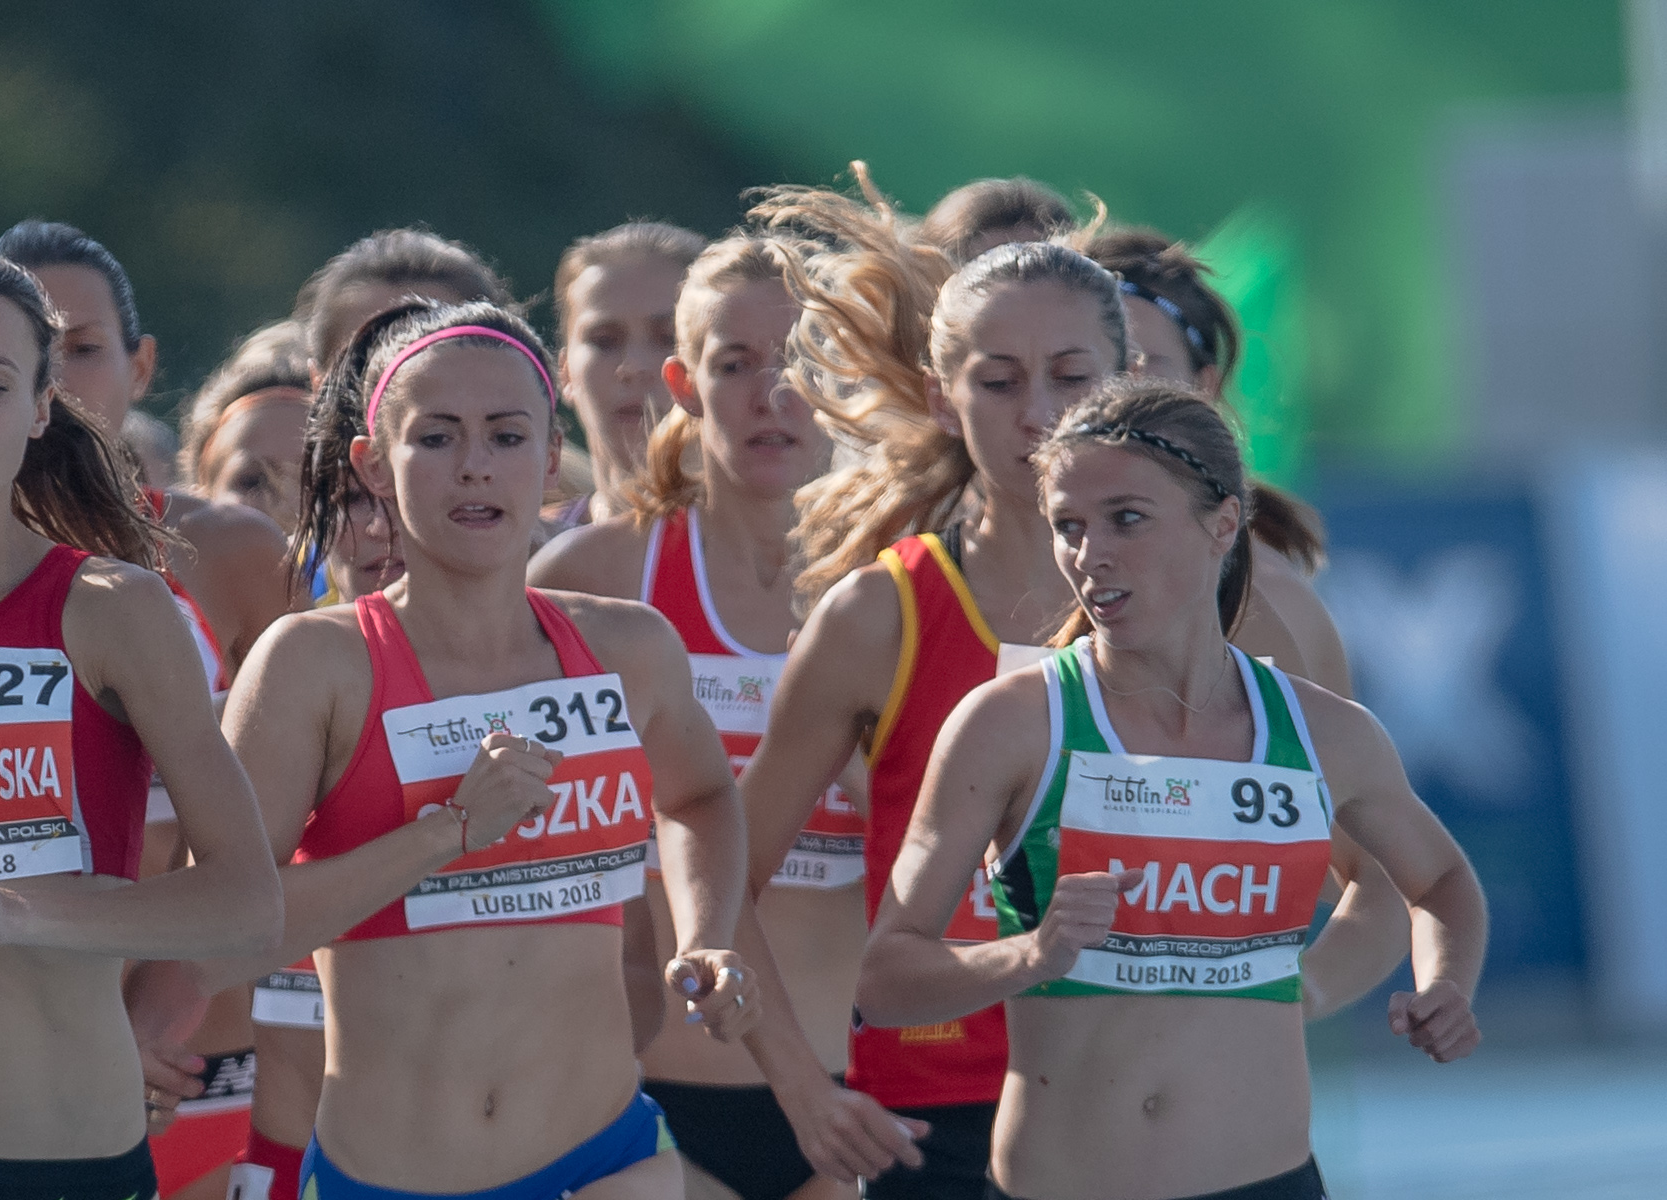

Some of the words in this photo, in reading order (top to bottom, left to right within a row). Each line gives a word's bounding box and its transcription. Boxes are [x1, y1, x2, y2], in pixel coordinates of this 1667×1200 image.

[529, 688, 632, 743] 312
[397, 717, 485, 747] lublin
[1079, 774, 1161, 804] lublin
[1231, 777, 1300, 828] 93
[8, 822, 67, 839] POLSKI
[448, 874, 489, 890] PZLA
[492, 859, 595, 885] MISTRZOSTWA
[598, 848, 642, 867] POLSKI
[472, 891, 553, 915] LUBLIN
[558, 880, 602, 906] 2018
[1107, 857, 1283, 916] MACH
[1104, 937, 1138, 952] ZLA
[1140, 939, 1248, 955] MISTRZOSTWA
[1250, 932, 1299, 948] POLSKI
[1115, 963, 1195, 984] LUBLIN
[1203, 961, 1252, 984] 2018
